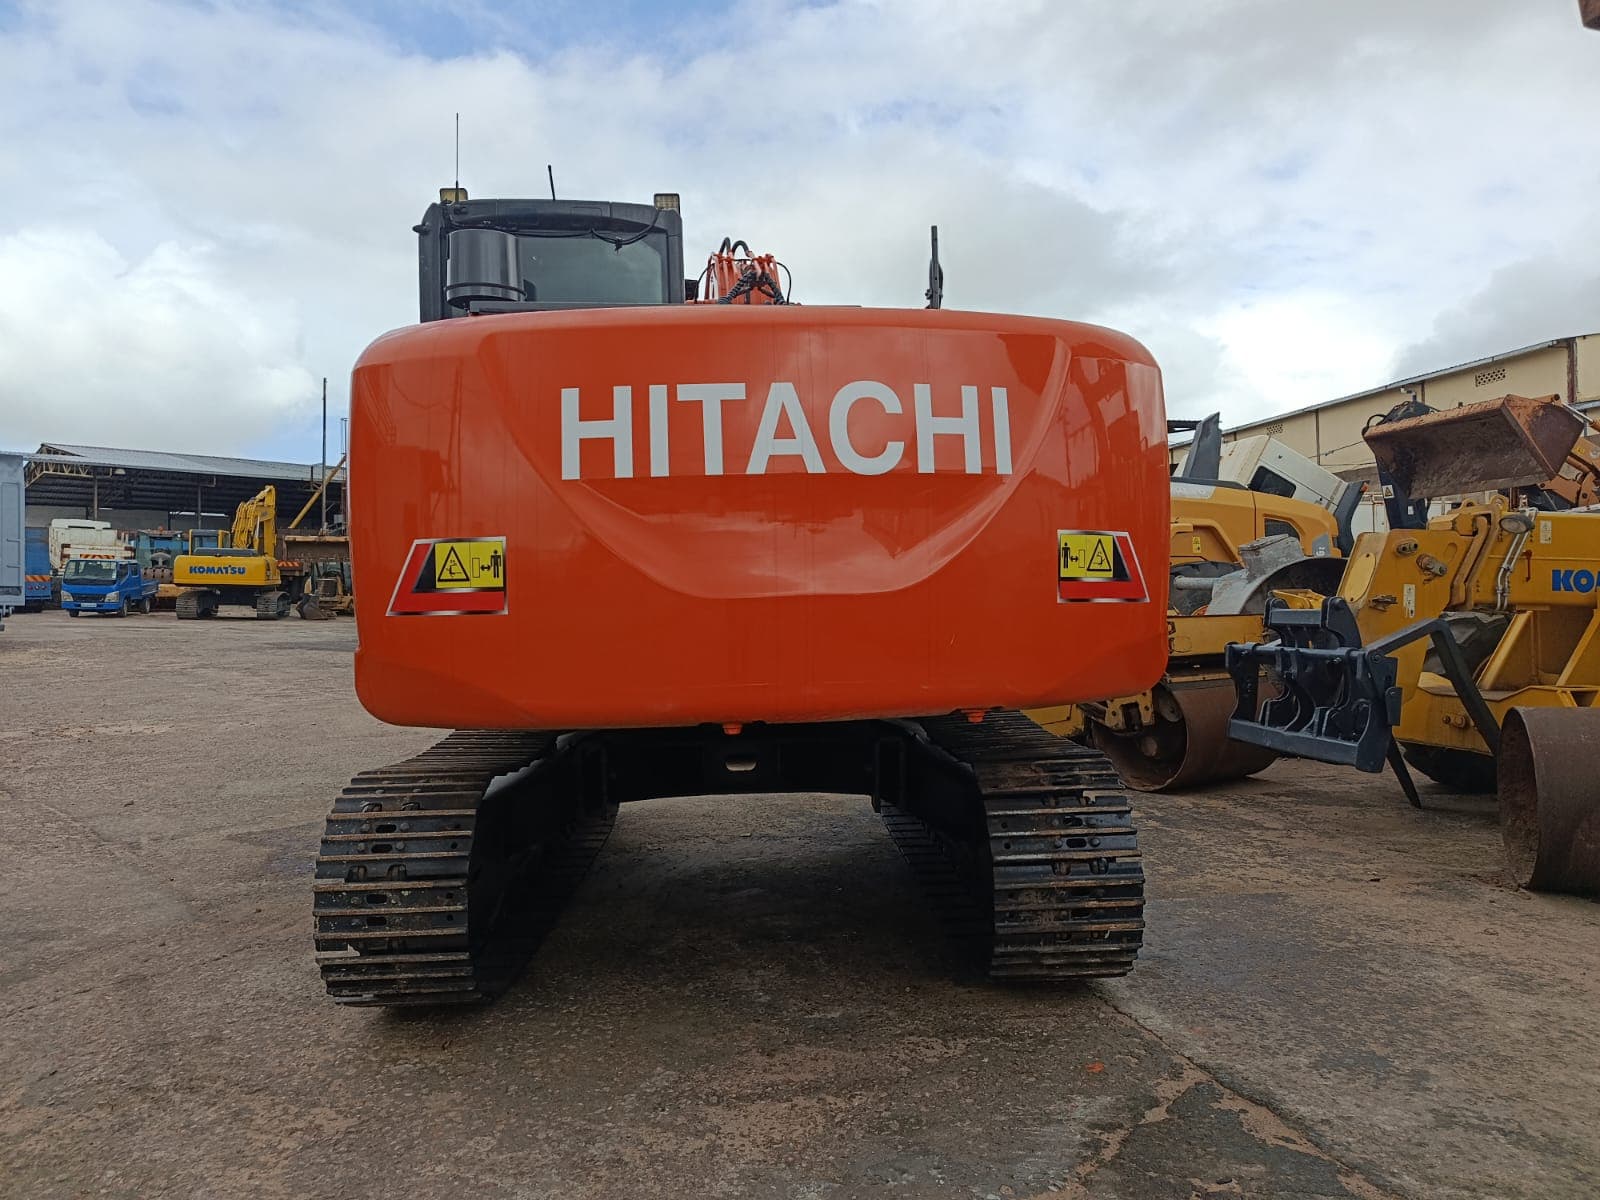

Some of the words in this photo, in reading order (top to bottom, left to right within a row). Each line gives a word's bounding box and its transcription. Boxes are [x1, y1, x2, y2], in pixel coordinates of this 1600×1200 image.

[561, 381, 1012, 480] HITACHI
[189, 566, 246, 575] KOMATSU
[1551, 569, 1600, 593] KO
